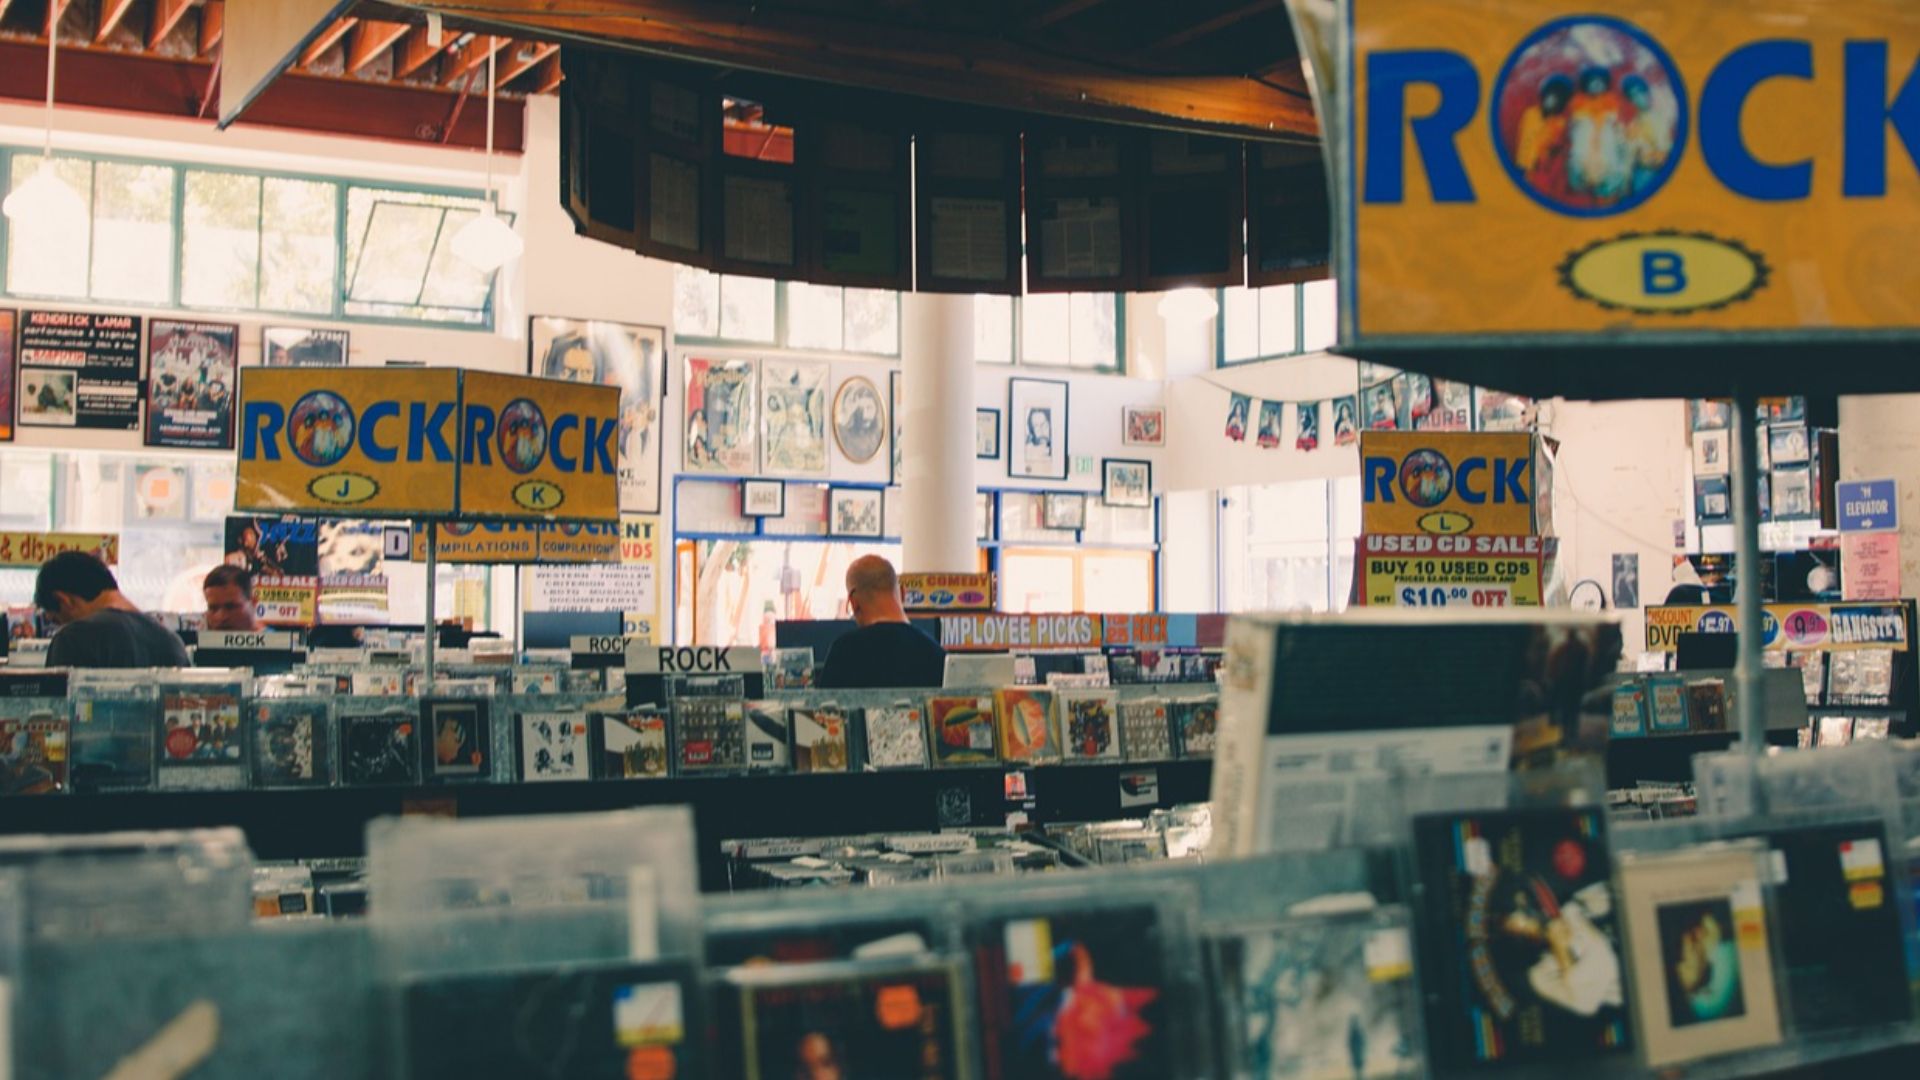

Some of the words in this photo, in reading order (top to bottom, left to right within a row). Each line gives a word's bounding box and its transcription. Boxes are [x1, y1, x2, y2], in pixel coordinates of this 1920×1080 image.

[1363, 14, 1920, 218] ROCK
[1641, 251, 1687, 295] B
[31, 312, 90, 326] KENDRICK
[95, 315, 132, 328] LAMAR
[242, 390, 457, 467] ROCK
[463, 398, 618, 474] ROCK
[1364, 448, 1529, 507] ROCK
[336, 479, 350, 496] J
[532, 487, 546, 504] K
[1846, 499, 1889, 516] ELEVATOR
[1439, 516, 1451, 530] L
[418, 541, 529, 553] CMPILATIONS
[1367, 535, 1433, 552] USED
[1437, 536, 1471, 552] CD
[1476, 536, 1540, 553] SALE
[1371, 560, 1409, 575] BUY
[1414, 561, 1435, 575] 10
[1441, 561, 1489, 575] USED
[1494, 561, 1530, 576] CDS
[927, 576, 987, 587] COMEDY
[1472, 590, 1507, 607] OFF
[1648, 609, 1693, 624] DISCOUNT
[1037, 616, 1092, 645] PICKS
[1132, 614, 1168, 645] ROCK
[1831, 613, 1904, 643] GANGSTER
[224, 634, 265, 647] ROCK
[658, 646, 731, 671] ROCK
